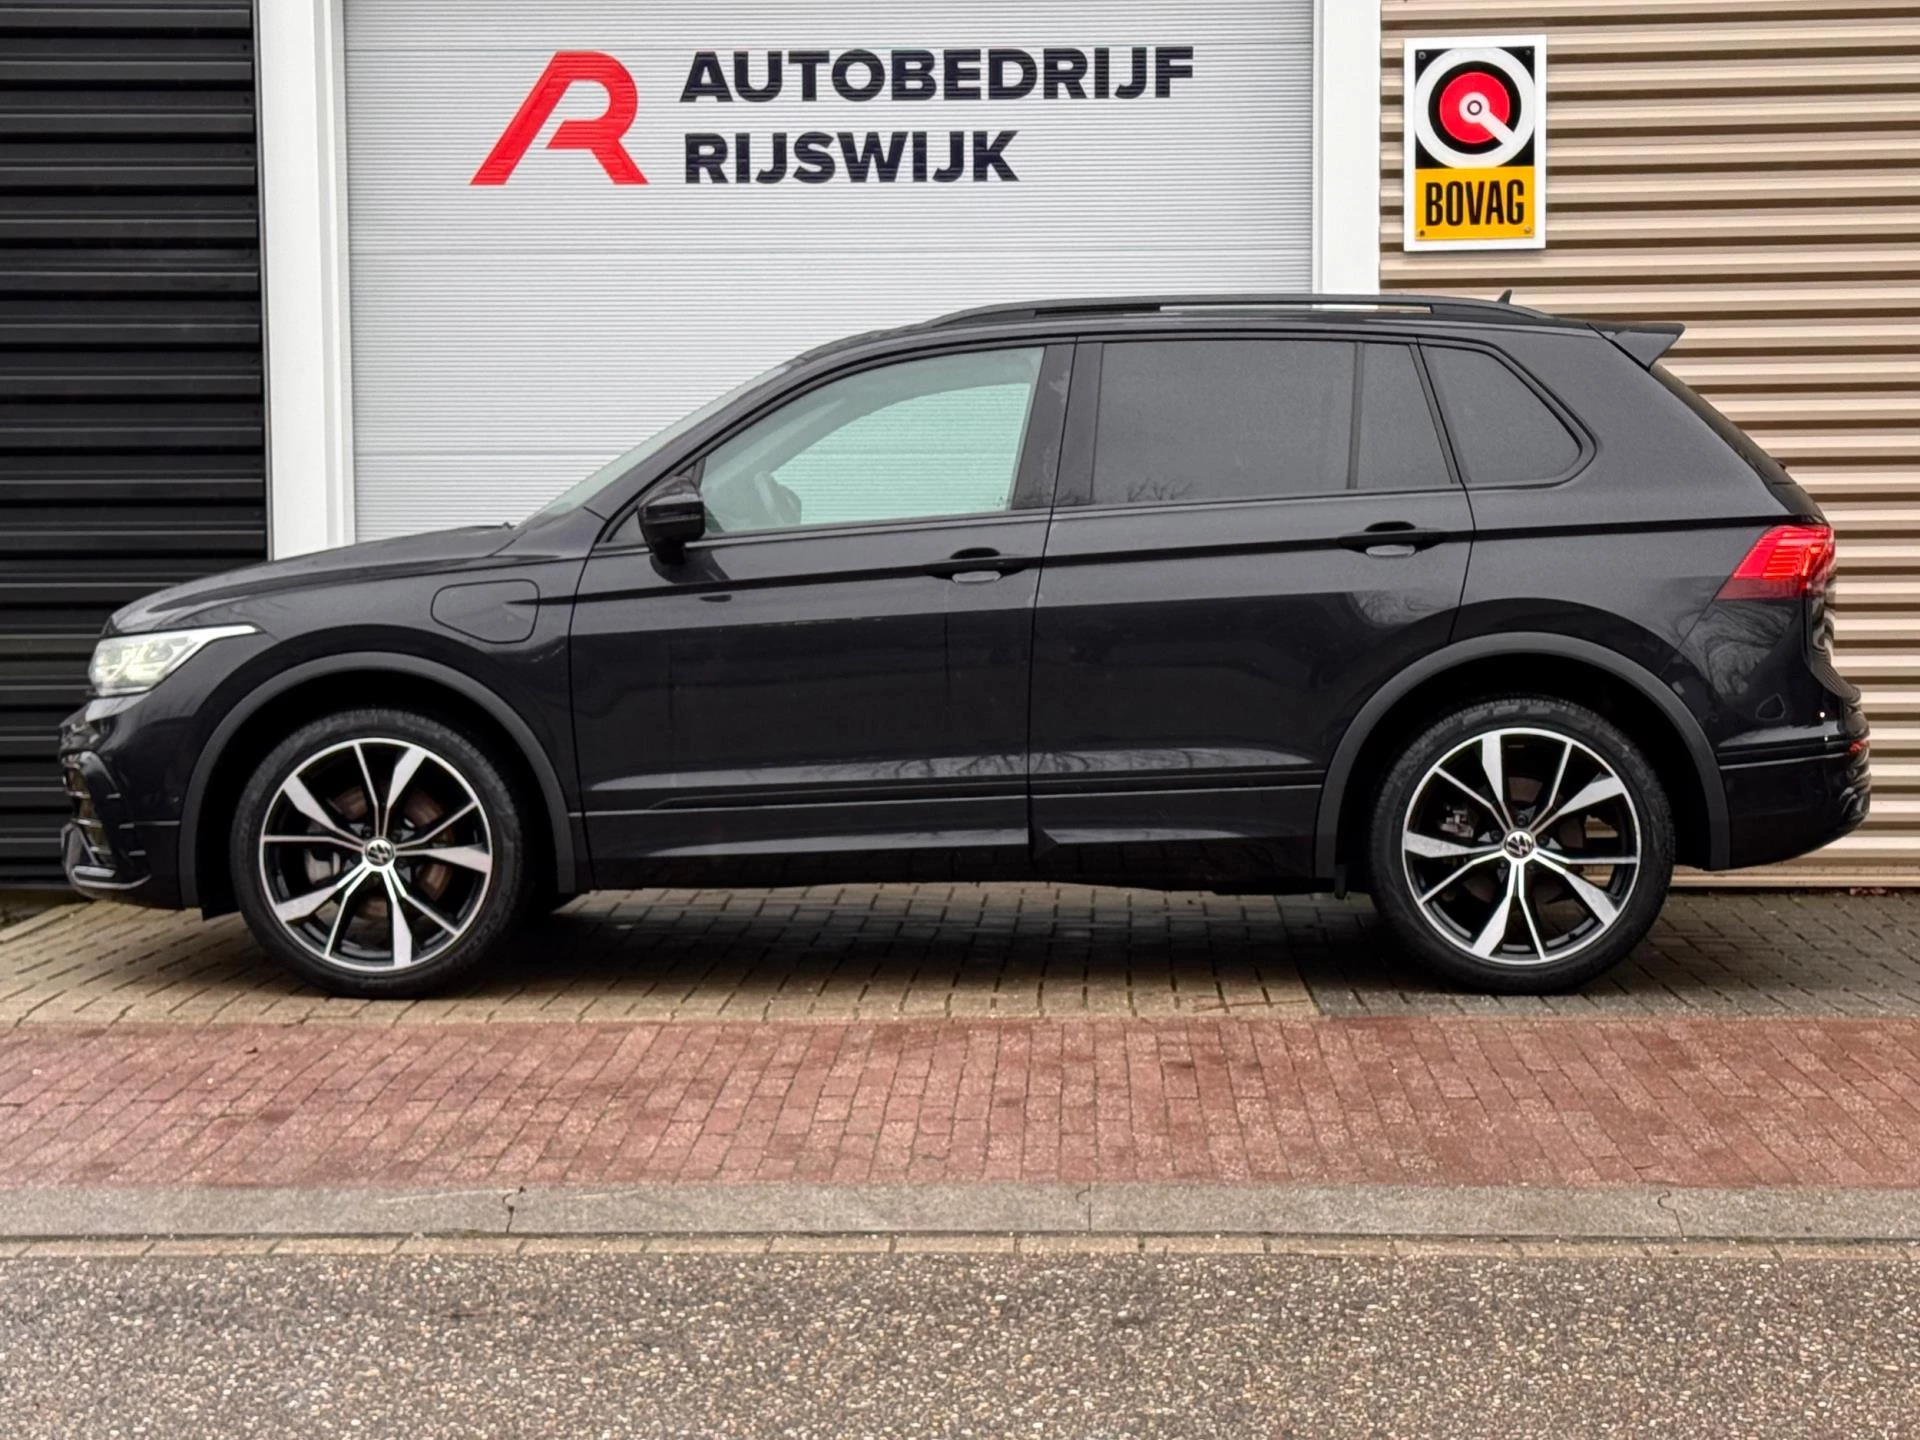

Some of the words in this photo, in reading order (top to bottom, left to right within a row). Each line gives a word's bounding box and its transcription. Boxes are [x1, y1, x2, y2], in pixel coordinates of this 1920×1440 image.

[679, 46, 1194, 103] AUTOBEDRIJF
[684, 130, 1020, 184] RIJSWIJK
[1425, 179, 1525, 226] BOVAG
